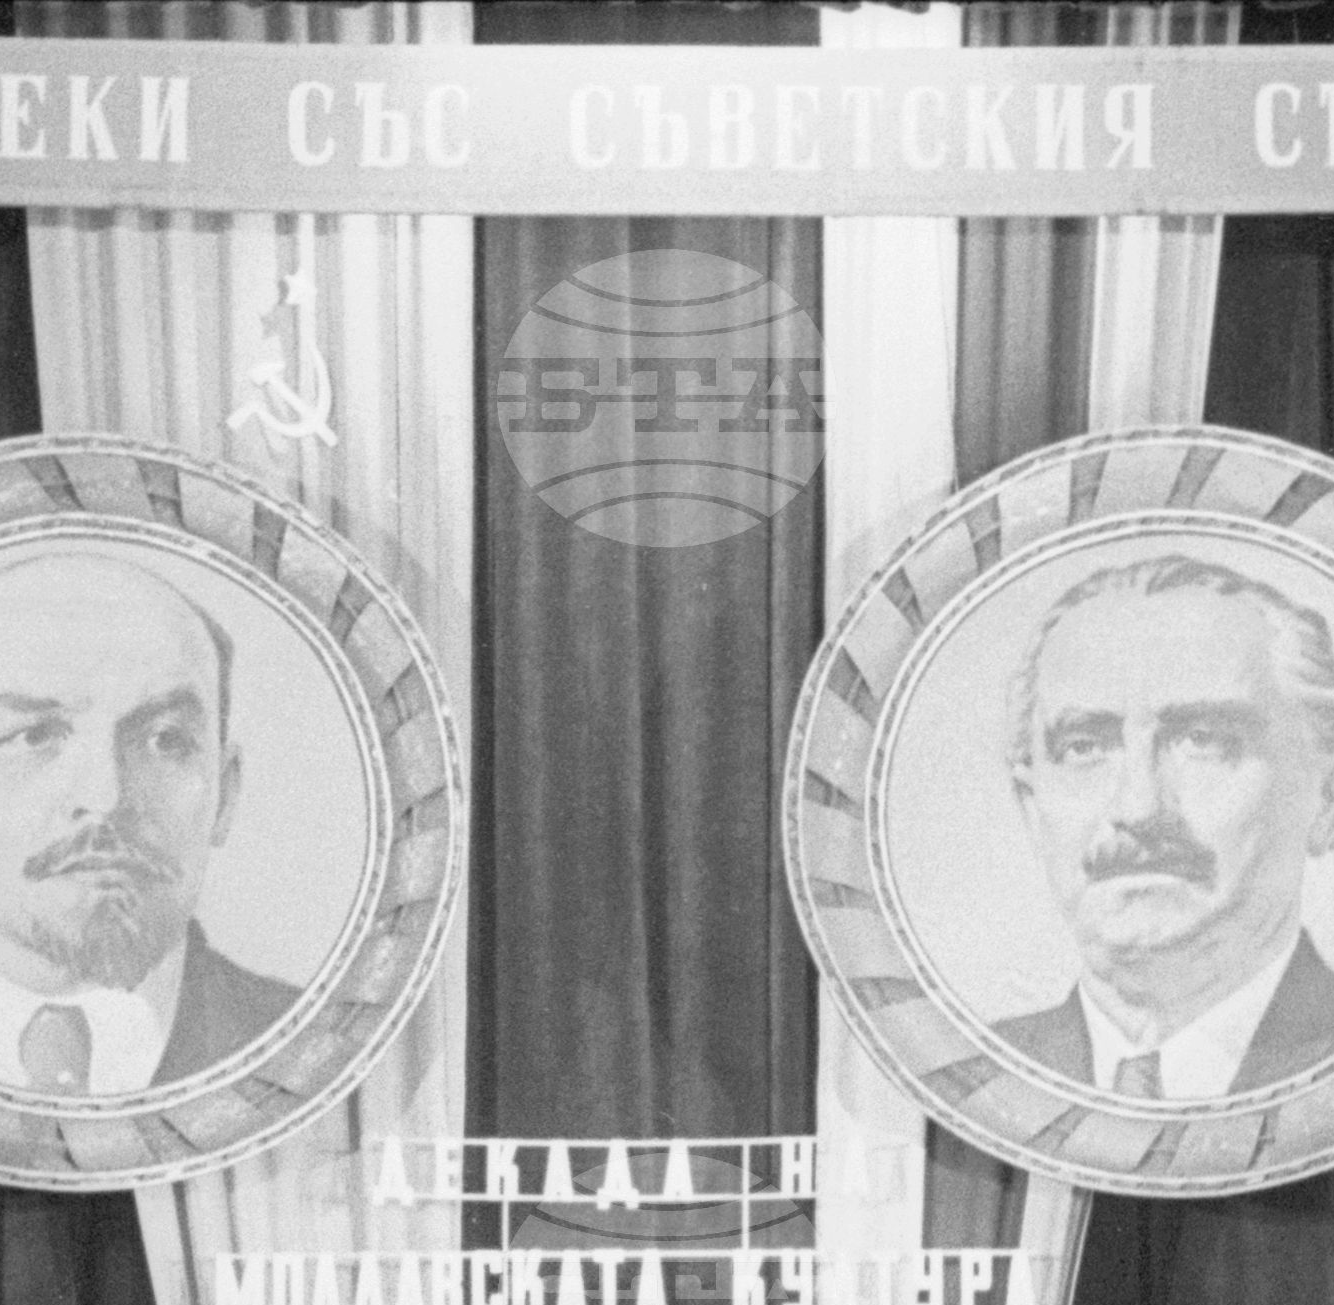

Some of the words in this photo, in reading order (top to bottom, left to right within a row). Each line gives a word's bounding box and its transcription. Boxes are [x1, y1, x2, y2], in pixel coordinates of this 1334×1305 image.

[287, 80, 471, 169] СЪС
[568, 82, 1155, 171] СЪВЕТСКИЯ
[372, 1136, 693, 1208] ДЕКАДА
[779, 1136, 870, 1200] НА
